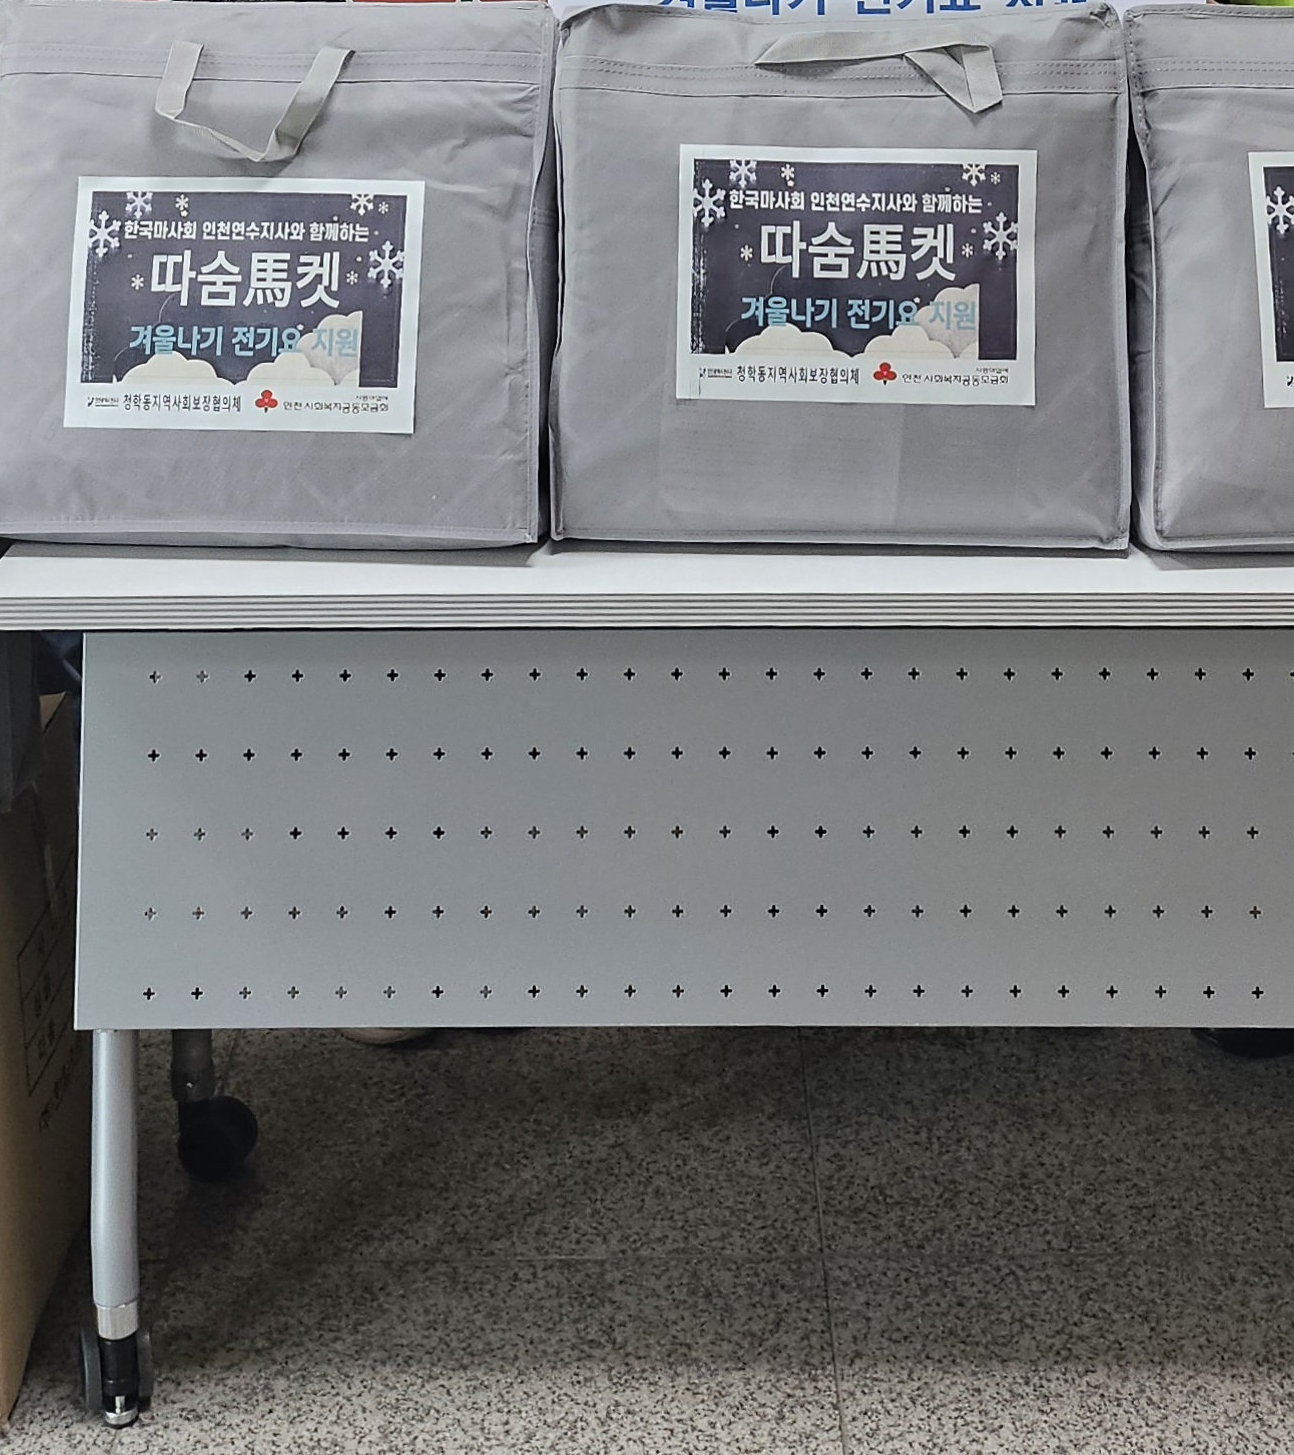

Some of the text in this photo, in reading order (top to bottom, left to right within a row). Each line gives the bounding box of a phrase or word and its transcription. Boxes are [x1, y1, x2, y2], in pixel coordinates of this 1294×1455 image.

[729, 189, 983, 214] 한국마사회 인천연수지사와 함께하는
[123, 221, 369, 243] 한국마사회 인천연수지사와 함께하는
[760, 220, 957, 281] 따숨馬켓
[150, 249, 341, 309] 따숨馬켓
[740, 296, 977, 331] 겨울나기 전기요 지원
[129, 324, 359, 358] 겨울나기 전기요 지원
